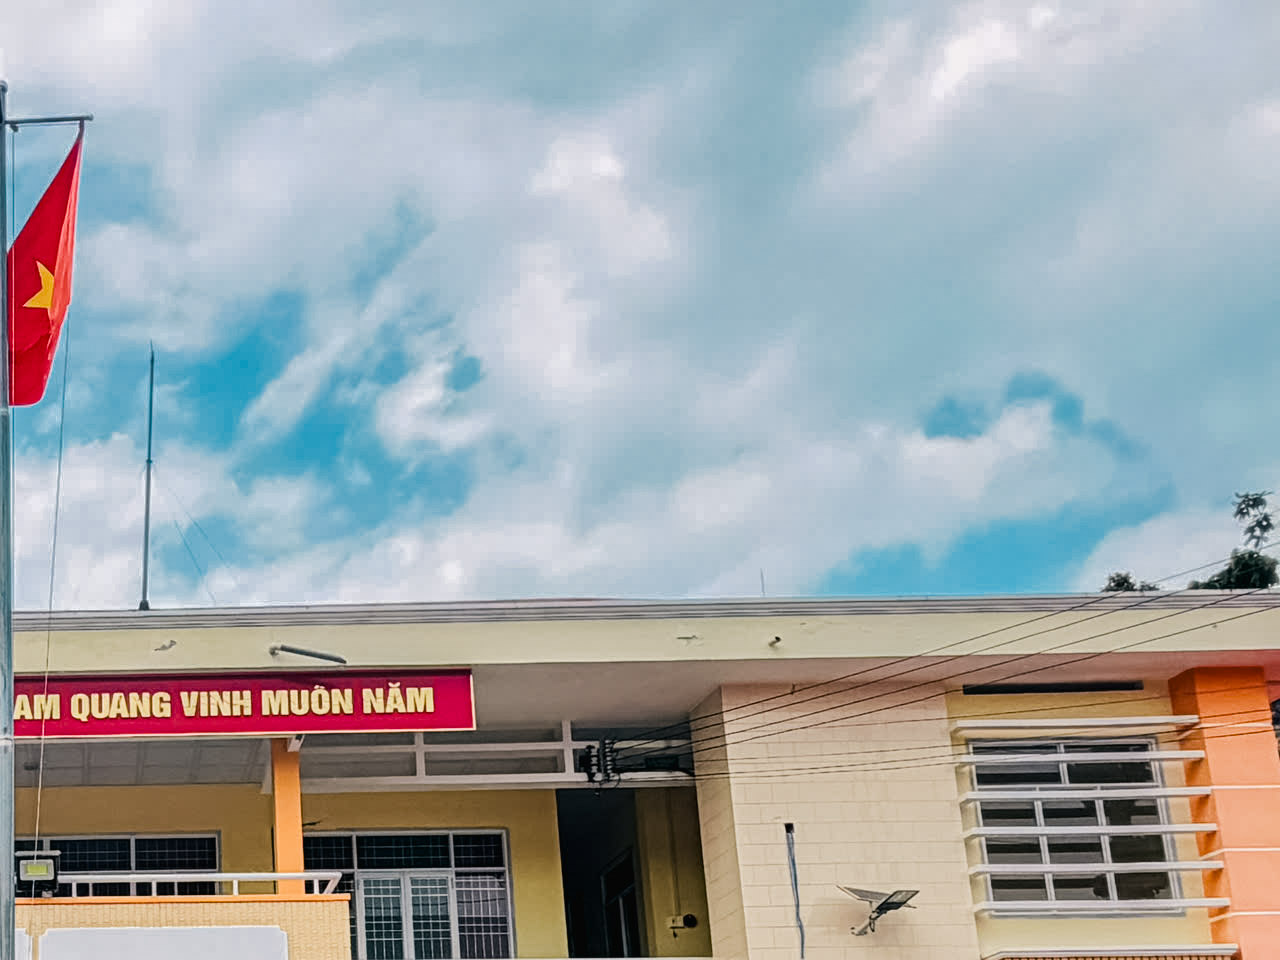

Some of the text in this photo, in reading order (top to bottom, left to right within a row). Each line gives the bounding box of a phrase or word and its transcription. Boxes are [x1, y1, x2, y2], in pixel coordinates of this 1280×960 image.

[70, 690, 171, 722] QUANG
[180, 690, 252, 717] VINH
[261, 684, 354, 716] MUÔN
[362, 681, 435, 713] NĂM
